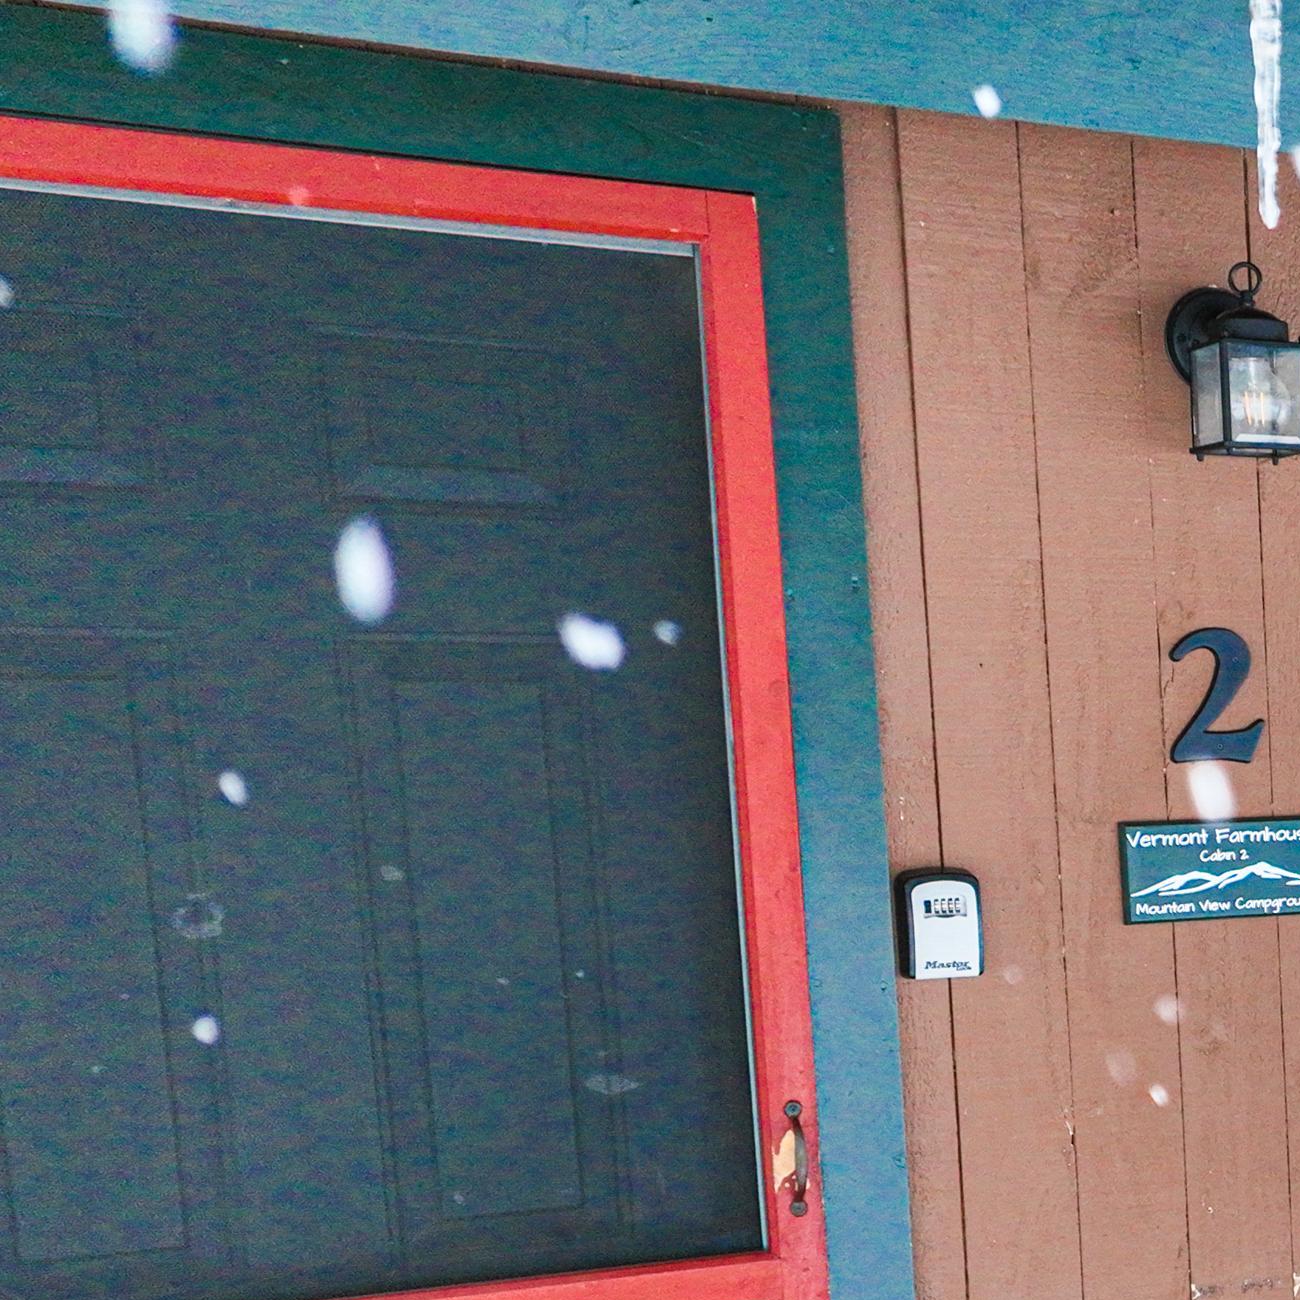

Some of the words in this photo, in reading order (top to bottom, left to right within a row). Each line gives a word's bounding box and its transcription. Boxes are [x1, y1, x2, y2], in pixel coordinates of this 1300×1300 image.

[1169, 627, 1264, 763] 2
[1126, 830, 1208, 848] Vermont
[1200, 849, 1235, 862] Cabin
[1240, 849, 1249, 861] 2
[1136, 901, 1195, 916] Mountain
[1199, 899, 1231, 911] View
[925, 961, 969, 969] Master
